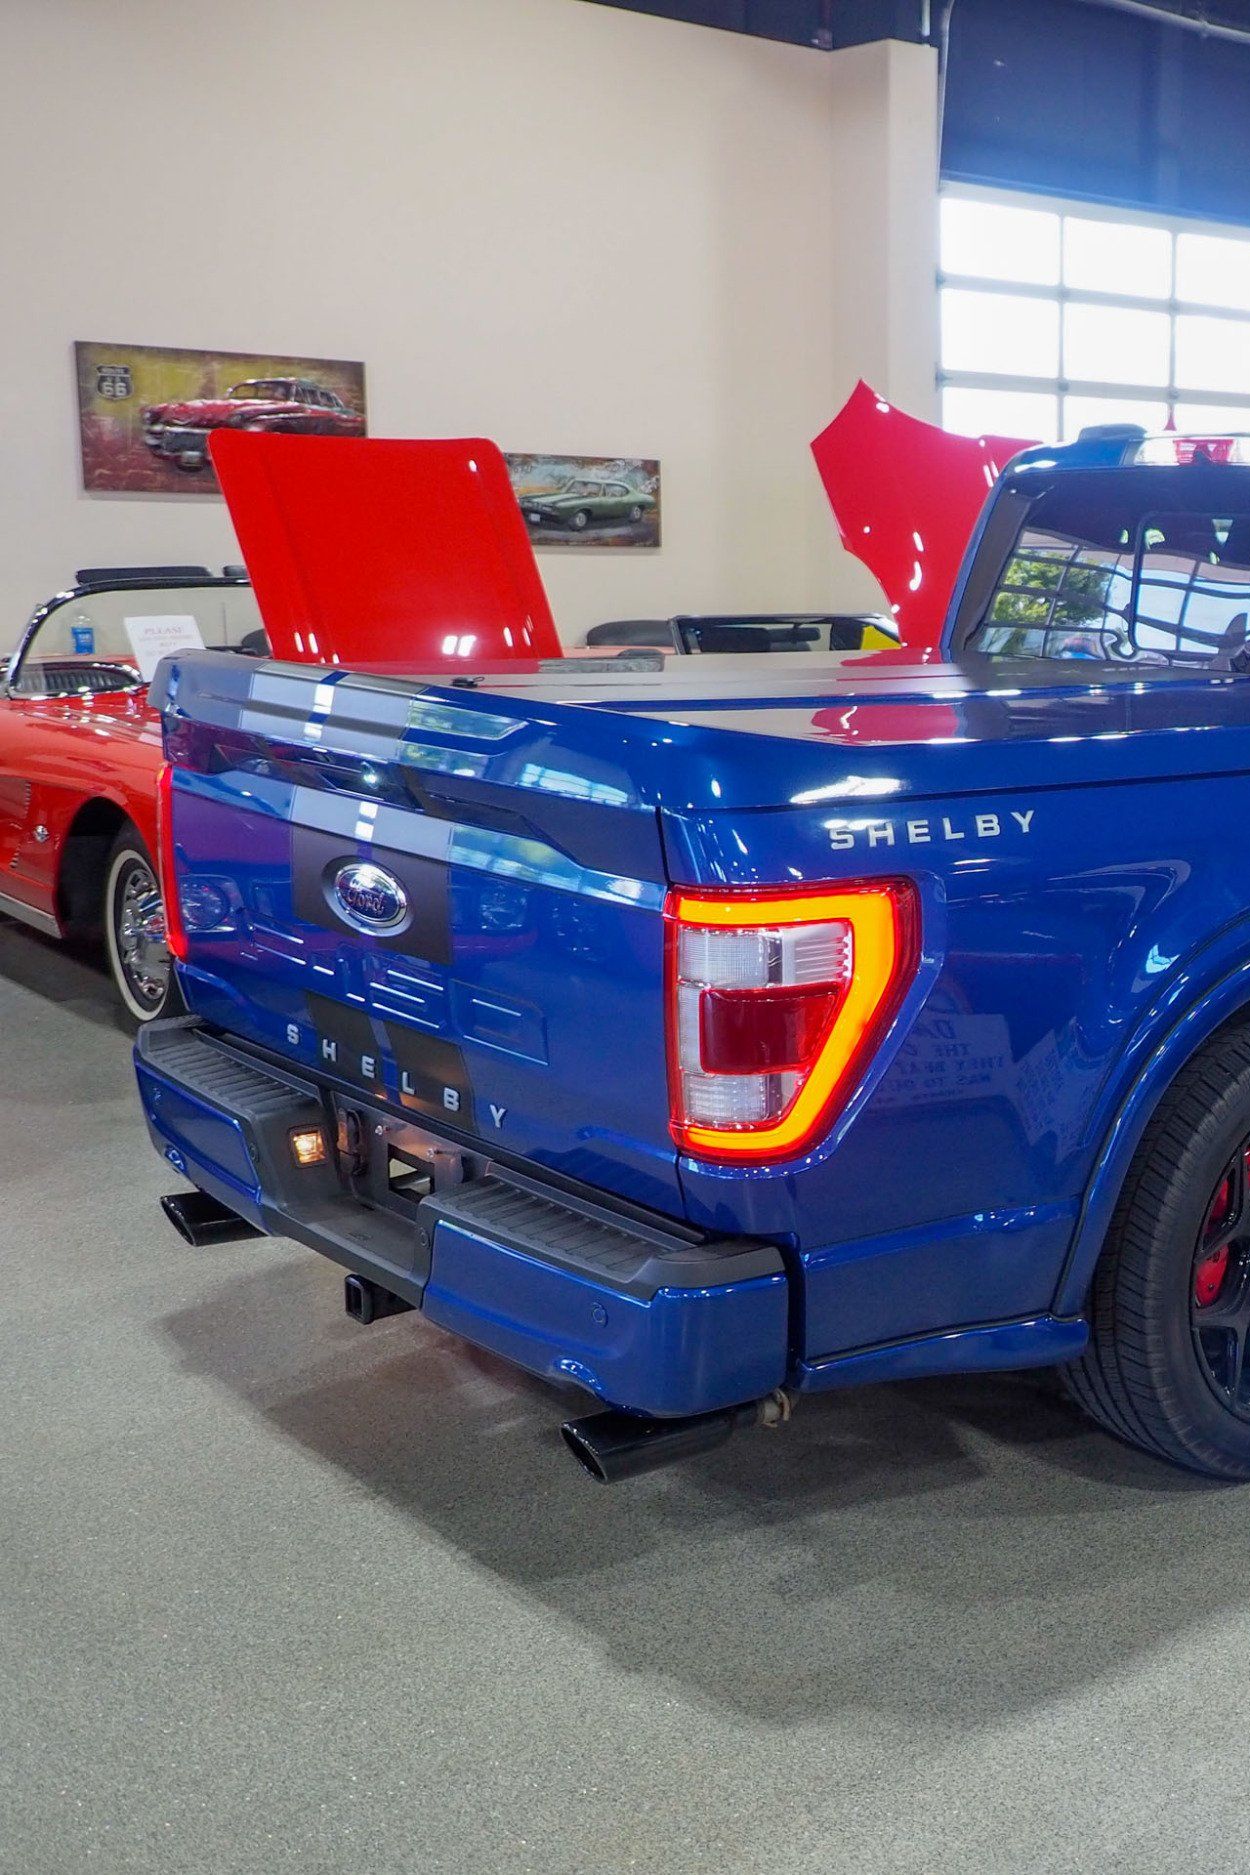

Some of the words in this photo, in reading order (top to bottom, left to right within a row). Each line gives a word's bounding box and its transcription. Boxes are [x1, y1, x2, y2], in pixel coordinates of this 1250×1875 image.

[103, 382, 128, 397] 66
[828, 809, 1035, 850] SHELBY
[345, 884, 387, 917] Ford
[286, 1023, 506, 1128] SHELBY
